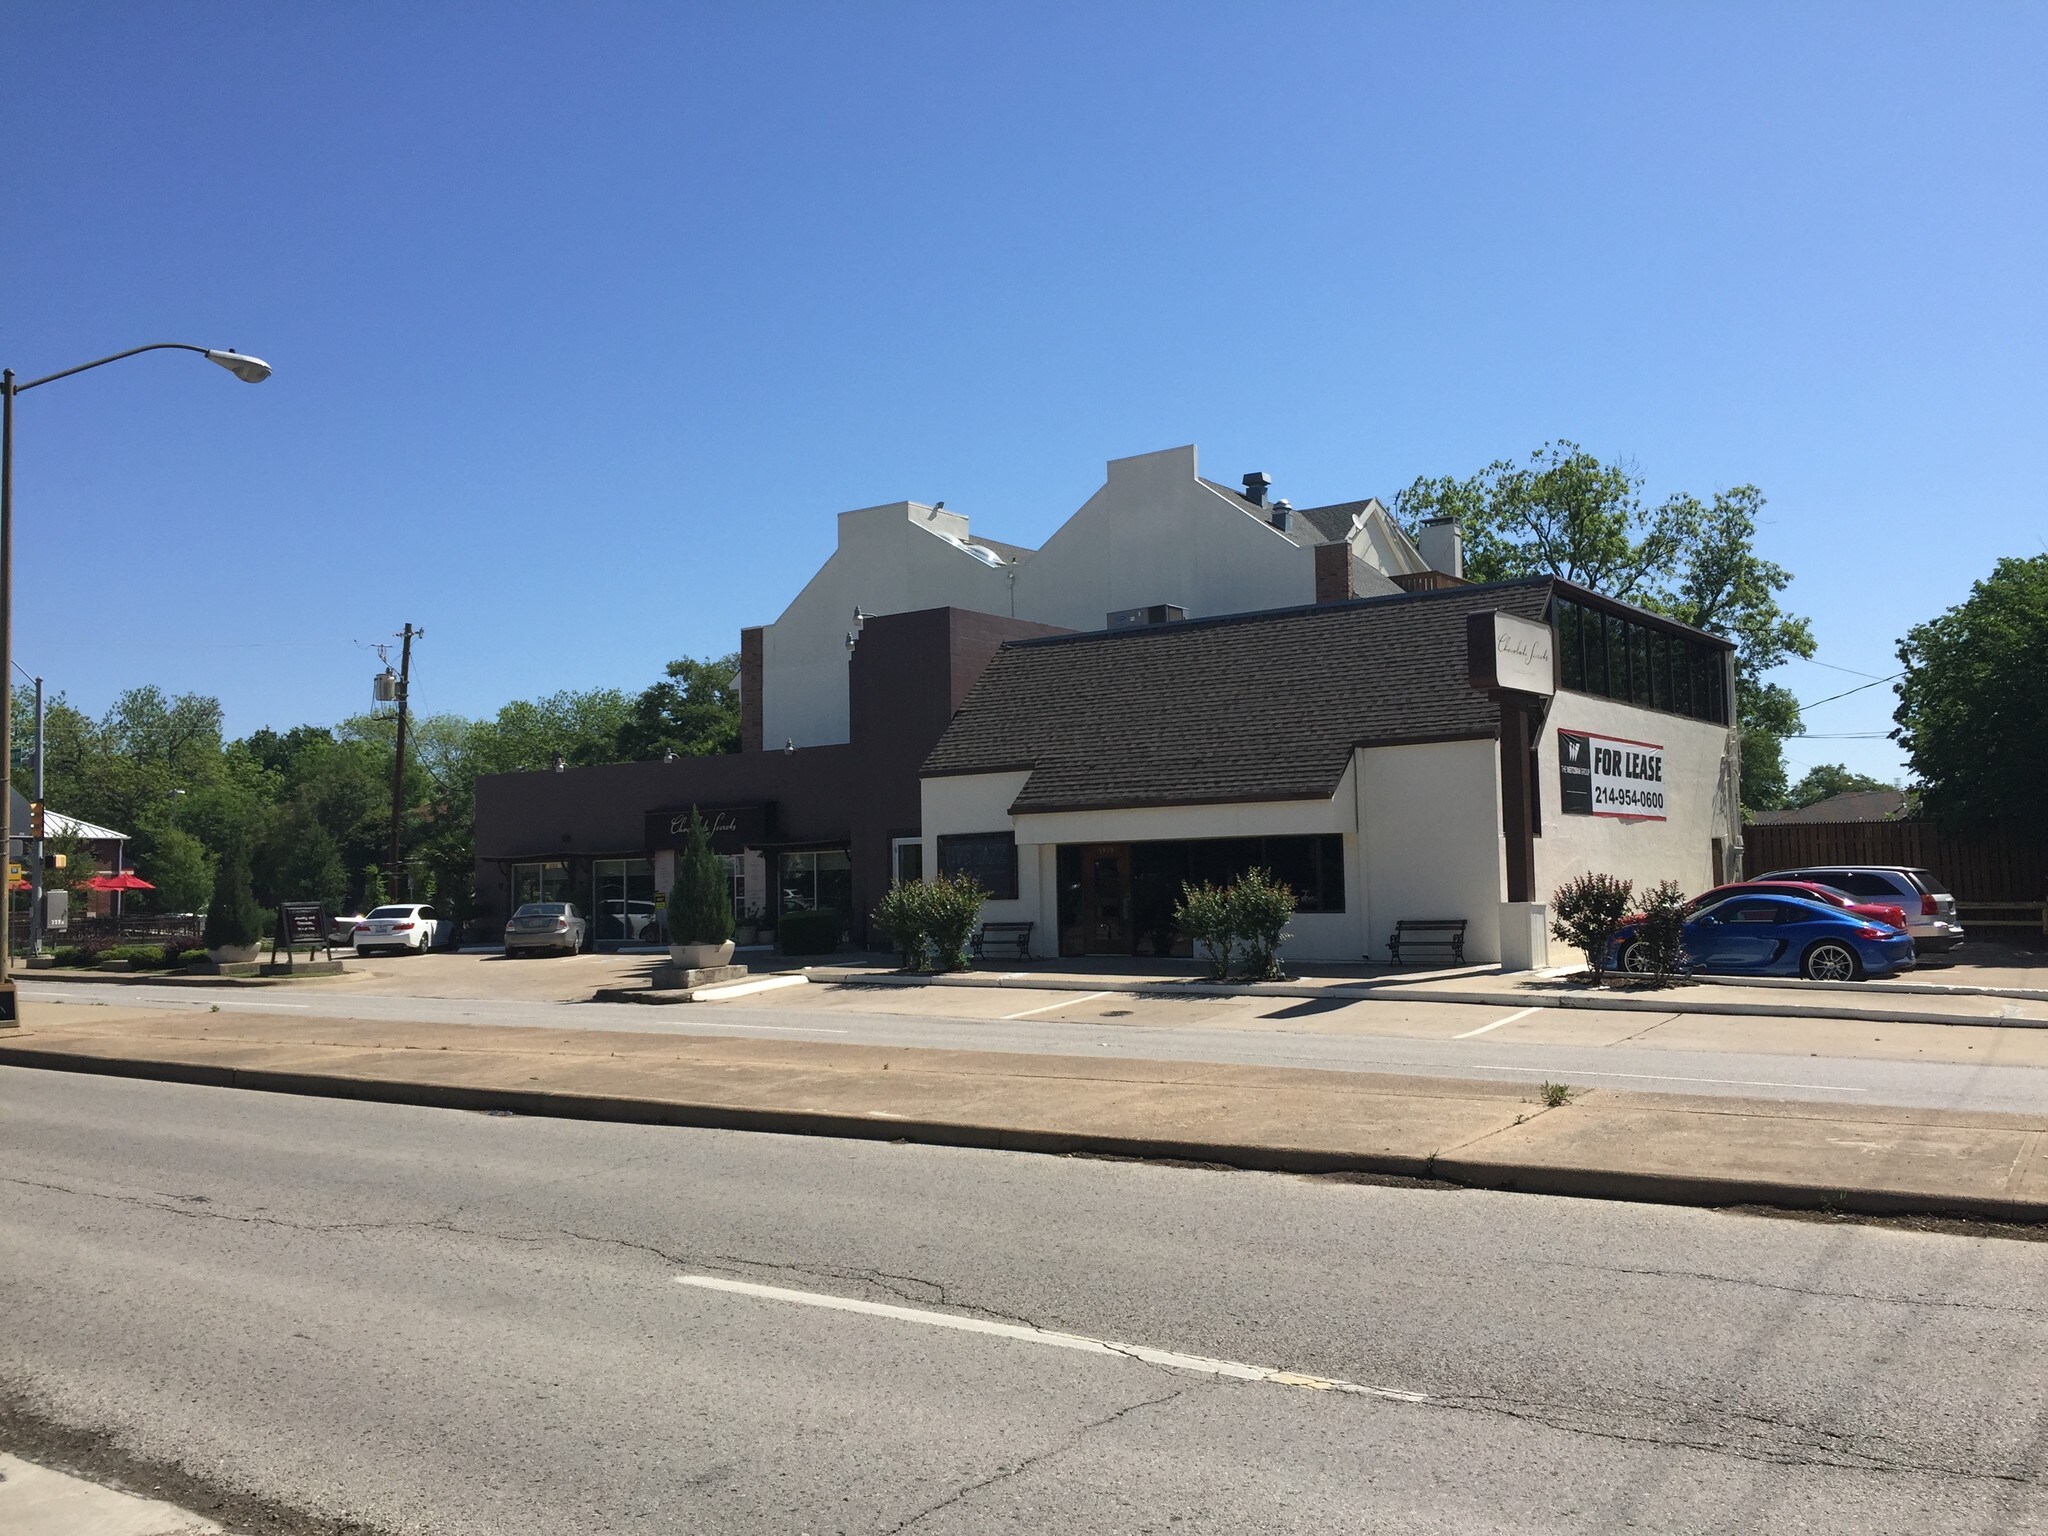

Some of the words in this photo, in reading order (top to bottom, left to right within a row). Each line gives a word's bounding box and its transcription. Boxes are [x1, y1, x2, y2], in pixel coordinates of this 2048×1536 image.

[1594, 747, 1622, 777] FOR
[1626, 752, 1662, 782] LEASE
[1595, 786, 1664, 809] 214-954-0600
